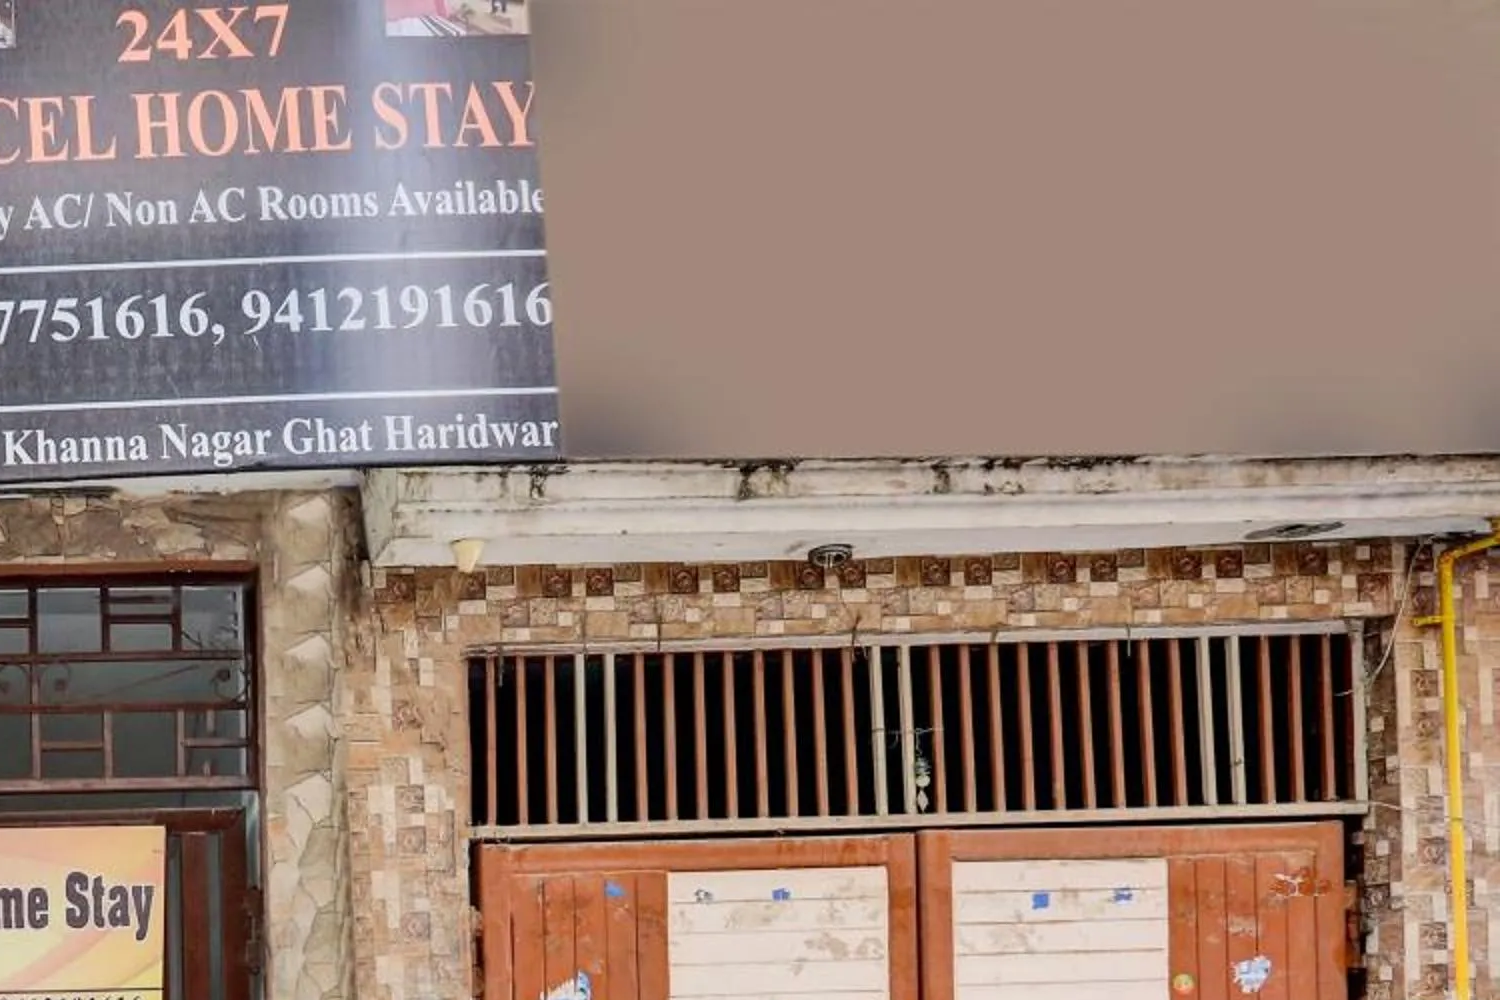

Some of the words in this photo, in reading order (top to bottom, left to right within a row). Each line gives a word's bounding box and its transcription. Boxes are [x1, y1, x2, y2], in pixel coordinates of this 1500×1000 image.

[116, 5, 289, 62] 24X7
[133, 85, 353, 160] HOME
[373, 79, 536, 150] STAY
[24, 192, 94, 230] AC/
[106, 192, 177, 227] Non
[191, 187, 246, 223] AC
[258, 185, 378, 222] Rooms
[388, 178, 544, 216] Available
[241, 282, 552, 337] 9412191616
[3, 428, 148, 467] Khanna
[160, 423, 268, 467] Nagar
[282, 417, 373, 456] Ghat
[385, 412, 559, 452] Haridwar
[65, 871, 155, 940] Stay
